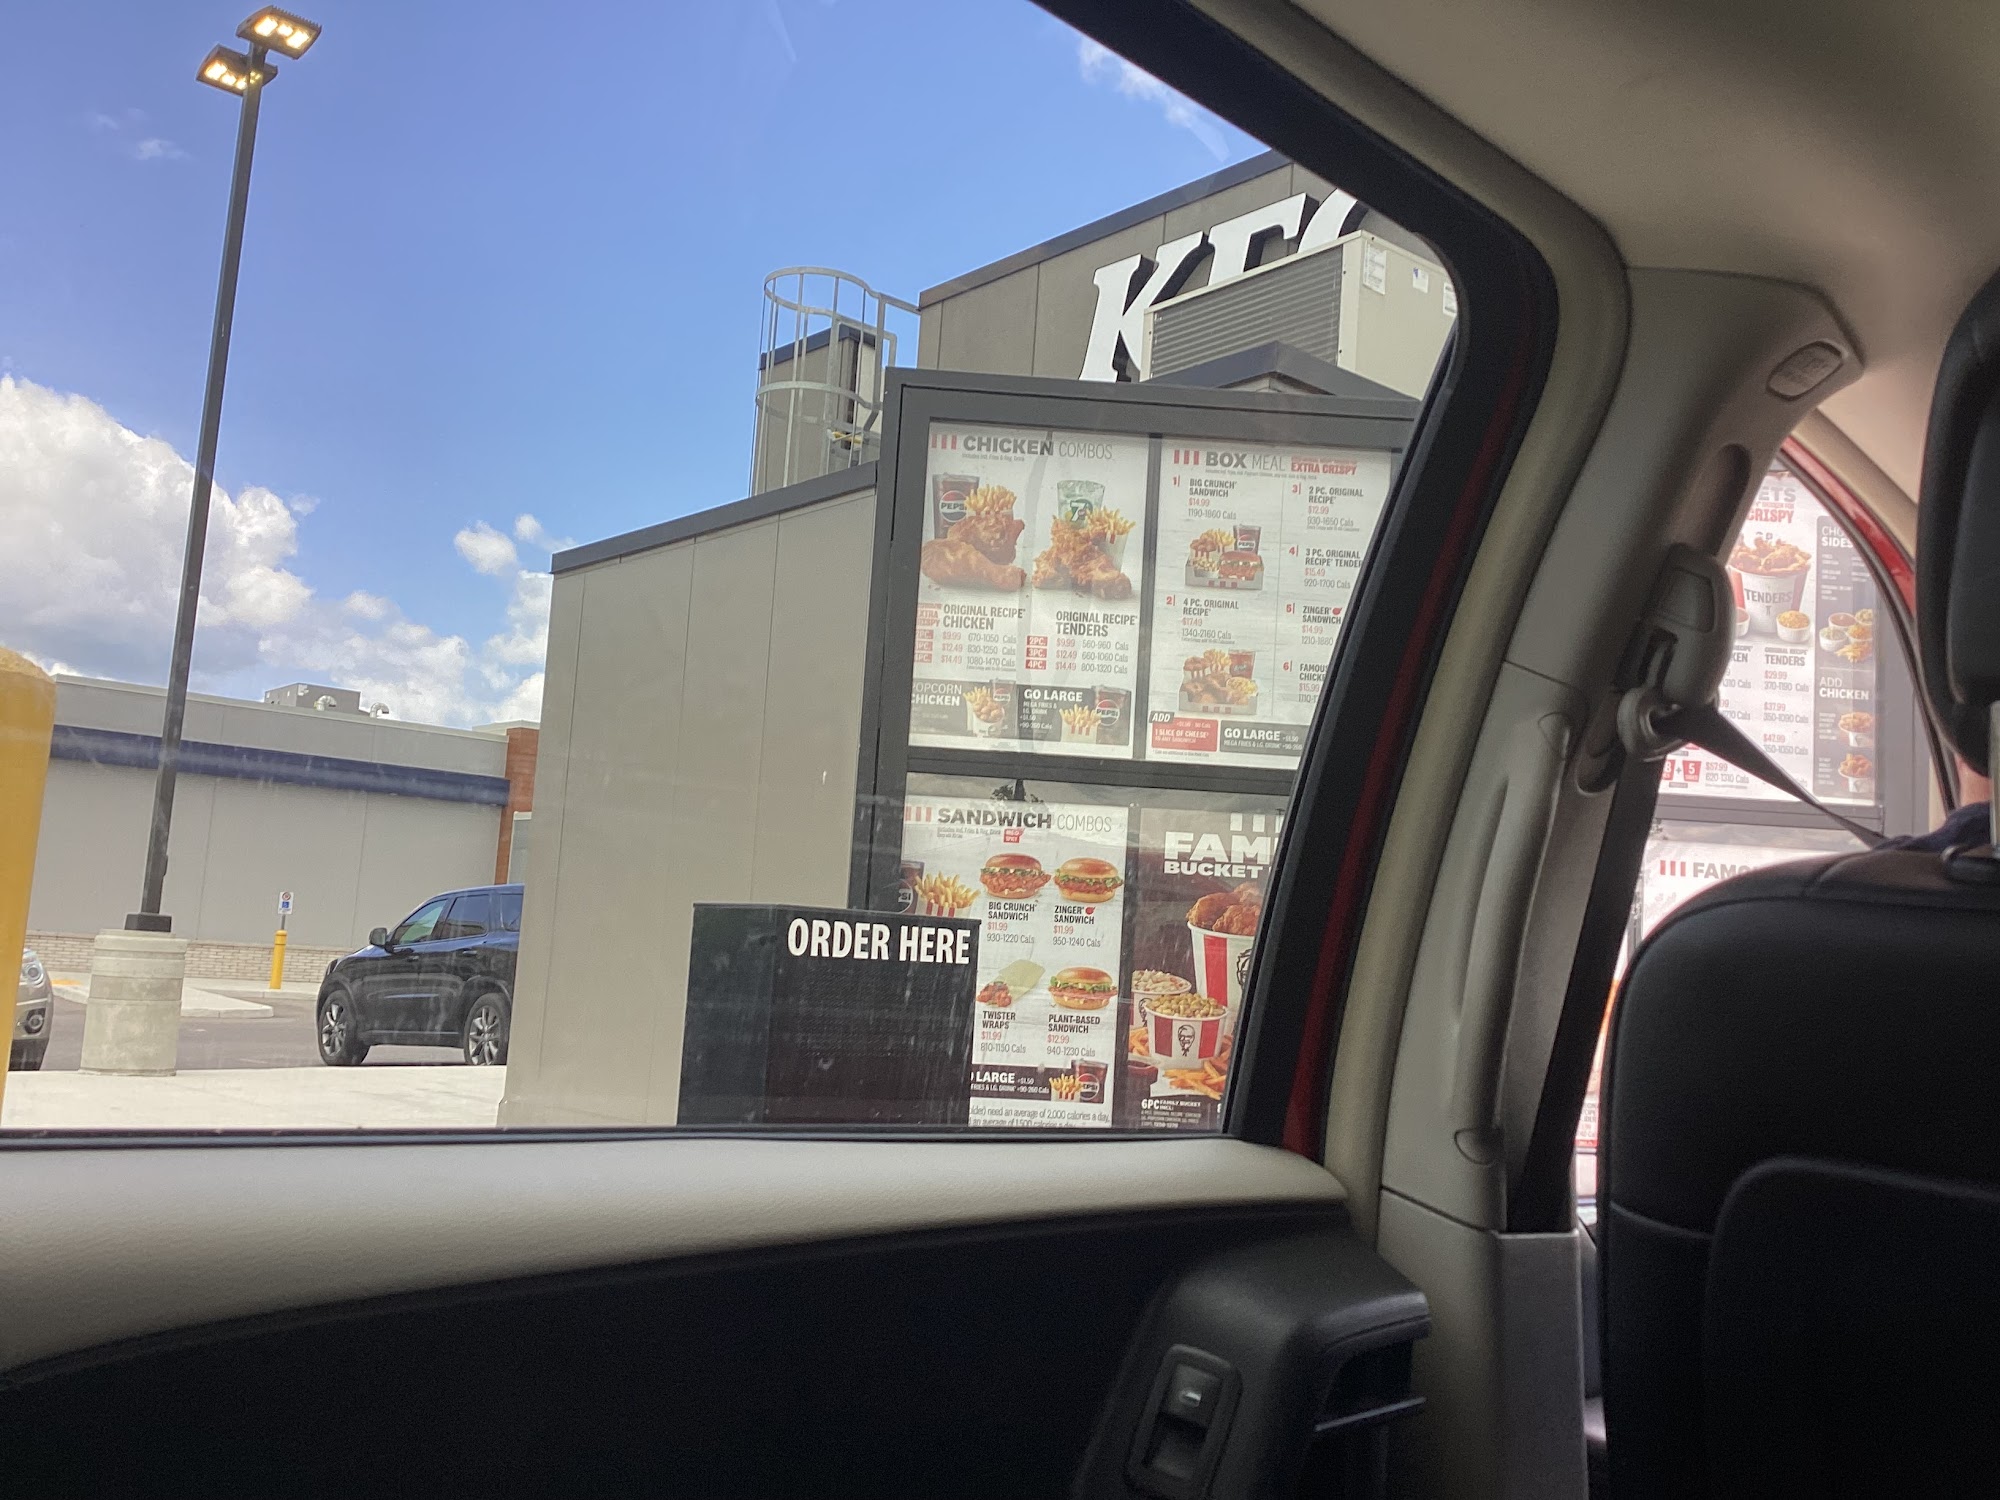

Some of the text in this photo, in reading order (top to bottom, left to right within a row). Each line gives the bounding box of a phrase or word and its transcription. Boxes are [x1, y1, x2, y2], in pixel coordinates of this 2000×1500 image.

[963, 435, 1112, 460] CHICKEN COMBOS
[1206, 452, 1247, 468] BOX
[1252, 454, 1285, 471] MEAL
[1291, 463, 1320, 473] EXTRA
[1323, 464, 1357, 475] CRISPY
[1190, 479, 1235, 489] BIG CRUNCH
[1292, 484, 1298, 494] 3
[1189, 488, 1228, 497] SANDWICH
[1309, 486, 1364, 497] 2 PC. ORIGINAL
[1308, 496, 1334, 505] RECIPE
[1222, 511, 1236, 519] Cals
[1340, 518, 1354, 527] Cals
[1822, 526, 1845, 537] CHO
[1289, 546, 1295, 555] 4
[1305, 548, 1360, 559] 3 PC. ORIGINAL
[1305, 557, 1331, 566] RECIPE
[1336, 580, 1351, 589] Cals
[1166, 596, 1172, 605] 2
[1744, 588, 1793, 604] TENDERS
[1183, 598, 1239, 609] 4 PC. ORIGINAL
[1286, 604, 1292, 613] 5
[943, 603, 988, 617] ORIGINAL
[1183, 607, 1209, 616] RECIPE
[942, 615, 994, 630] CHICKEN
[1056, 611, 1100, 623] ORIGINAL
[1302, 615, 1341, 625] SANDWICH
[1056, 622, 1108, 637] TENDERS
[1217, 630, 1232, 640] Cals
[1003, 635, 1017, 644] Cals
[1029, 637, 1046, 646] 2PC.
[1056, 638, 1075, 647] $9.99
[1115, 641, 1129, 651] Cals
[1002, 647, 1016, 656] Cals
[1028, 649, 1045, 658] 3PC.
[1056, 650, 1077, 660] $12.49
[1115, 653, 1128, 663] Cals
[1001, 658, 1015, 668] Cals
[1765, 654, 1805, 667] TENDERS
[1027, 661, 1045, 669] 4PC.
[1055, 661, 1076, 671] $14.49
[1114, 665, 1128, 675] Cals
[1283, 662, 1289, 671] 6
[1738, 680, 1751, 689] Cals
[1795, 683, 1809, 692] Cals
[1820, 677, 1842, 688] ADD
[1024, 689, 1083, 702] GO LARGE
[1820, 687, 1870, 701] CHICKEN
[1096, 708, 1119, 716] PEPSI
[1152, 712, 1171, 722] ADD
[1795, 714, 1809, 724] Cals
[1224, 728, 1281, 741] GO LARGE
[1688, 763, 1695, 774] 5
[938, 808, 1112, 832] SANDWICH COMBOS
[1164, 860, 1263, 879] BUCKET
[1692, 862, 1752, 880] FAMO
[988, 901, 1035, 912] BIG CRUNCH
[988, 911, 1028, 921] SANDWICH
[1054, 915, 1095, 925] SANDWICH
[987, 922, 1008, 931] $11.99
[1053, 925, 1074, 935] $11.99
[787, 917, 971, 964] ORDER HERE
[987, 933, 1035, 944] 930-1220 Cals
[1053, 936, 1101, 948] 950-1240 Cals
[983, 1010, 1016, 1021] TWISTER
[1048, 1014, 1101, 1025] PLANT-BASED
[982, 1020, 1009, 1030] WRAPS
[1048, 1023, 1089, 1034] SANDWICH
[981, 1030, 1002, 1041] $11.99
[1047, 1034, 1069, 1044] $12.99
[1011, 1044, 1026, 1054] Cals
[1047, 1045, 1095, 1057] 940-1230 Cals
[976, 1071, 1016, 1084] LARGE
[1142, 1099, 1160, 1110] 6PC
[988, 1105, 1004, 1117] need
[1005, 1108, 1013, 1117] an
[1014, 1109, 1038, 1120] average
[1039, 1108, 1046, 1118] of
[1067, 1110, 1092, 1121] calories
